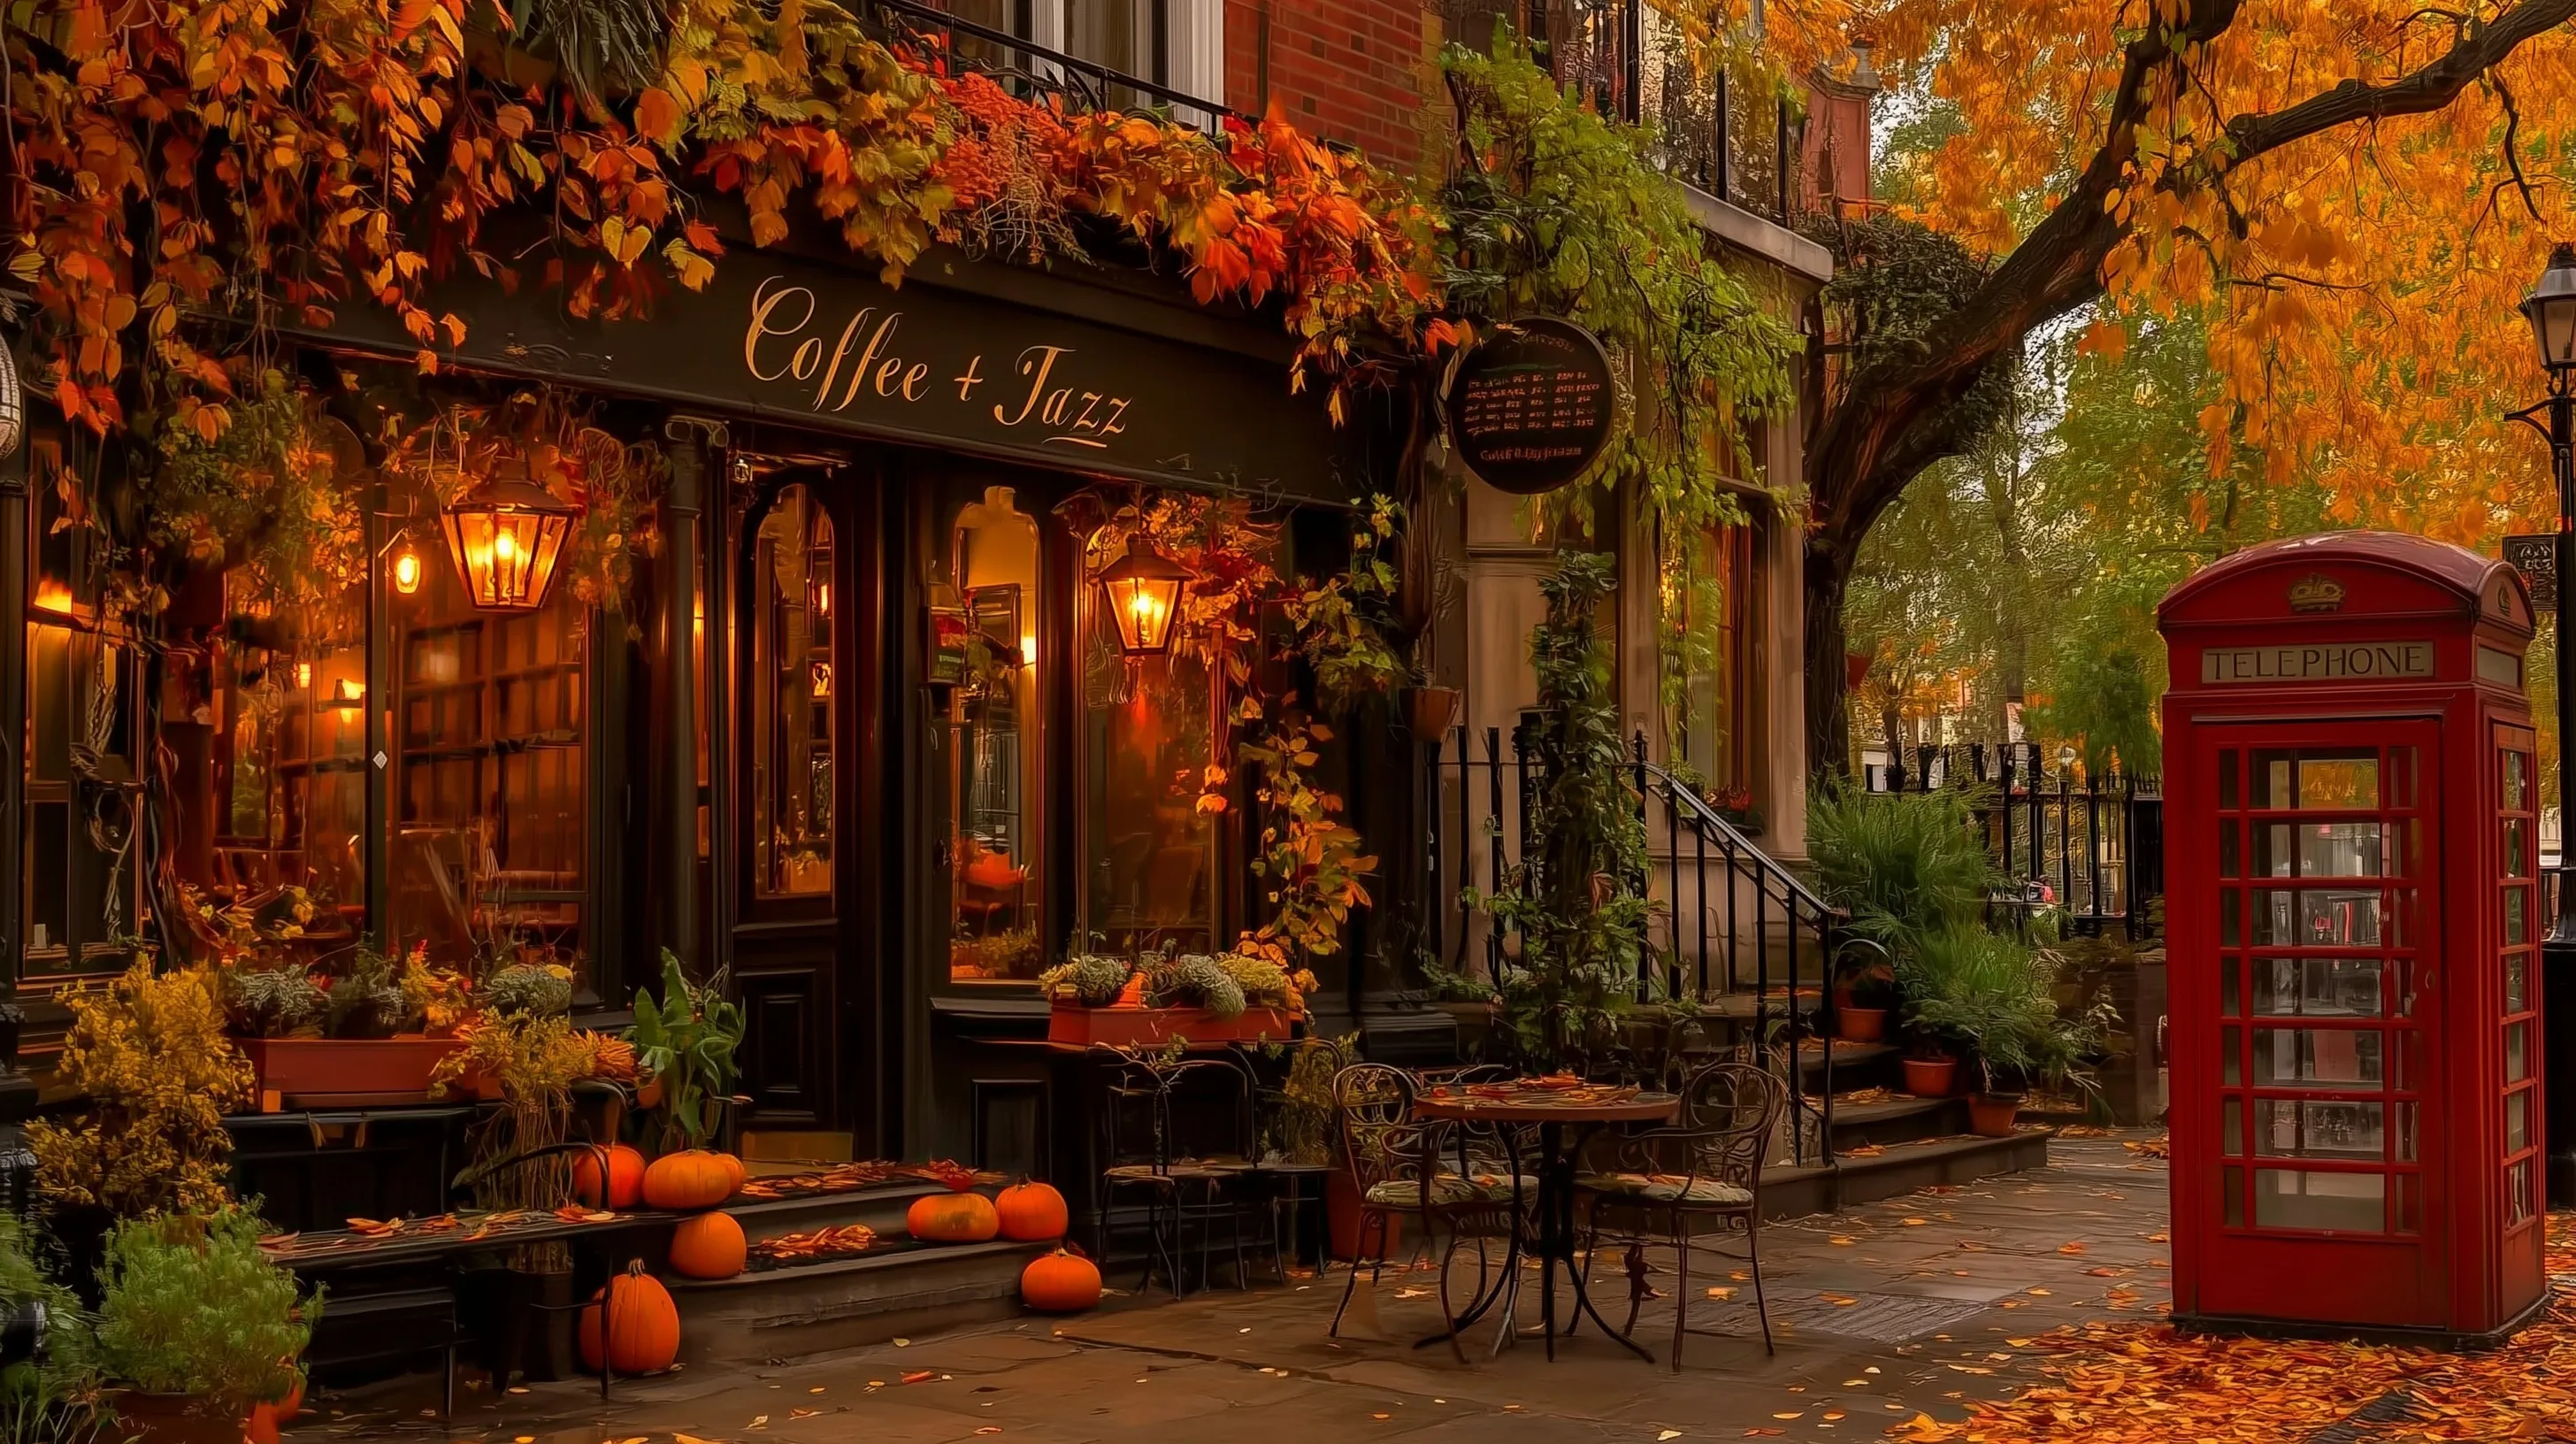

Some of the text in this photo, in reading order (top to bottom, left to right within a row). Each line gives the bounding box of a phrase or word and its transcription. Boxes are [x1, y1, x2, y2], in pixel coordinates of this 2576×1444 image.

[746, 275, 930, 412] Coffee
[993, 345, 1133, 436] Jazz
[2206, 646, 2425, 680] TELEPHONE
